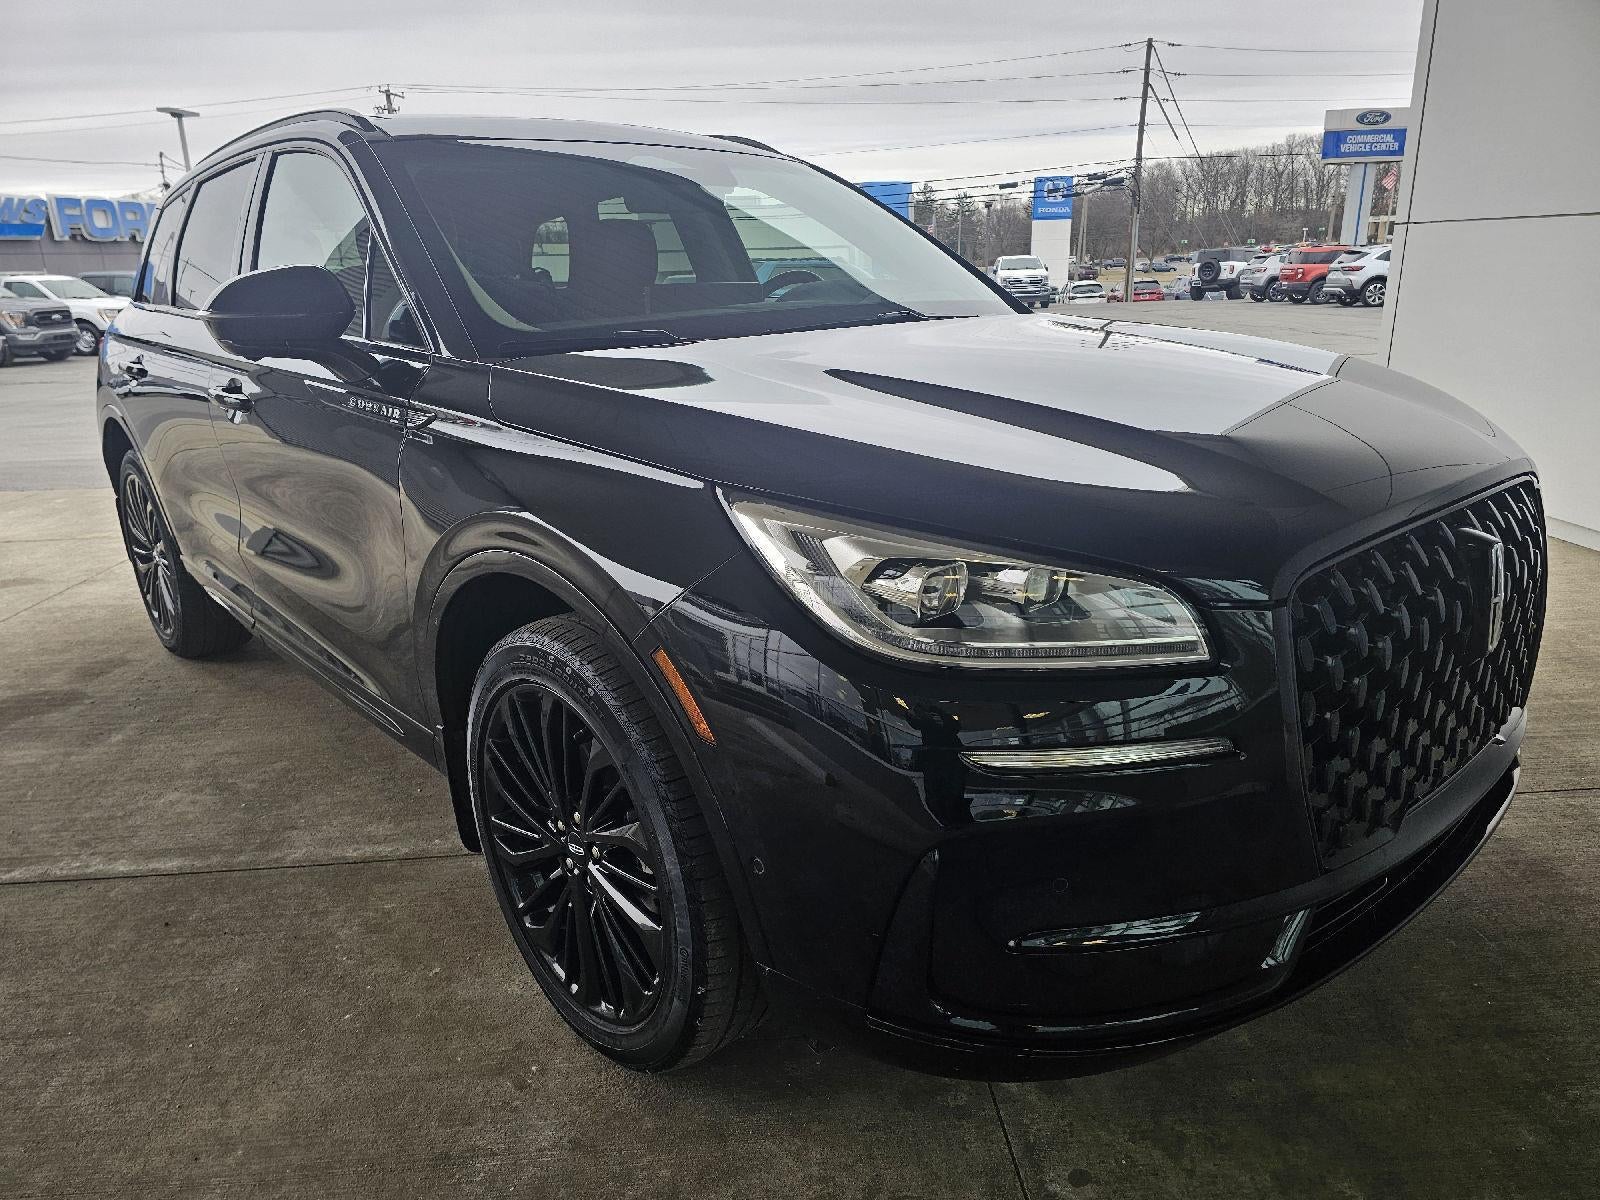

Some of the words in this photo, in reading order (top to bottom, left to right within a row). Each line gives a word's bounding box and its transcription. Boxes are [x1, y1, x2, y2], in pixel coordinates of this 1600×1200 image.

[1346, 134, 1395, 144] COMMERCIAL
[1340, 143, 1371, 153] VEHICLE
[1372, 142, 1399, 151] CENTER
[53, 196, 158, 241] FOR
